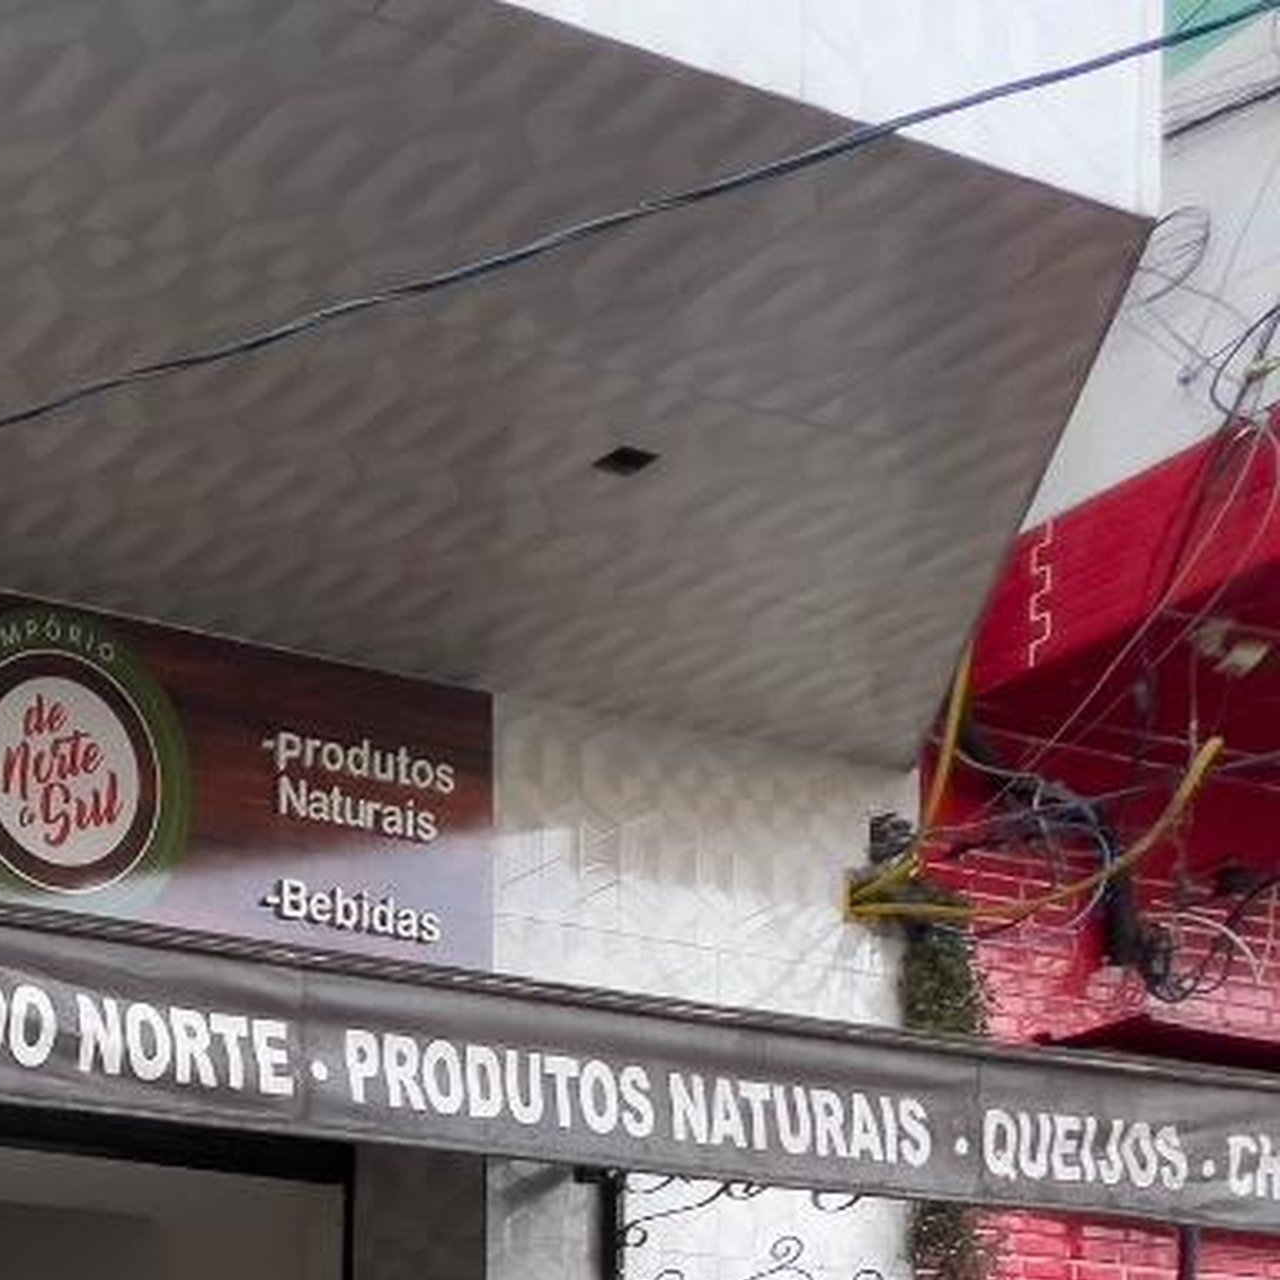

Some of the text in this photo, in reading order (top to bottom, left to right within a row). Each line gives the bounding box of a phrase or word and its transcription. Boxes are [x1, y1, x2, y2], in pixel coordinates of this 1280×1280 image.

[23, 693, 68, 736] de
[2, 730, 105, 800] Norte
[43, 770, 124, 847] Sul
[278, 774, 438, 841] Naturais
[75, 992, 296, 1096] NORTE
[345, 1029, 655, 1137] PRODUTOS
[668, 1071, 933, 1169] NATURAIS
[982, 1108, 1189, 1191] QUEIJOS
